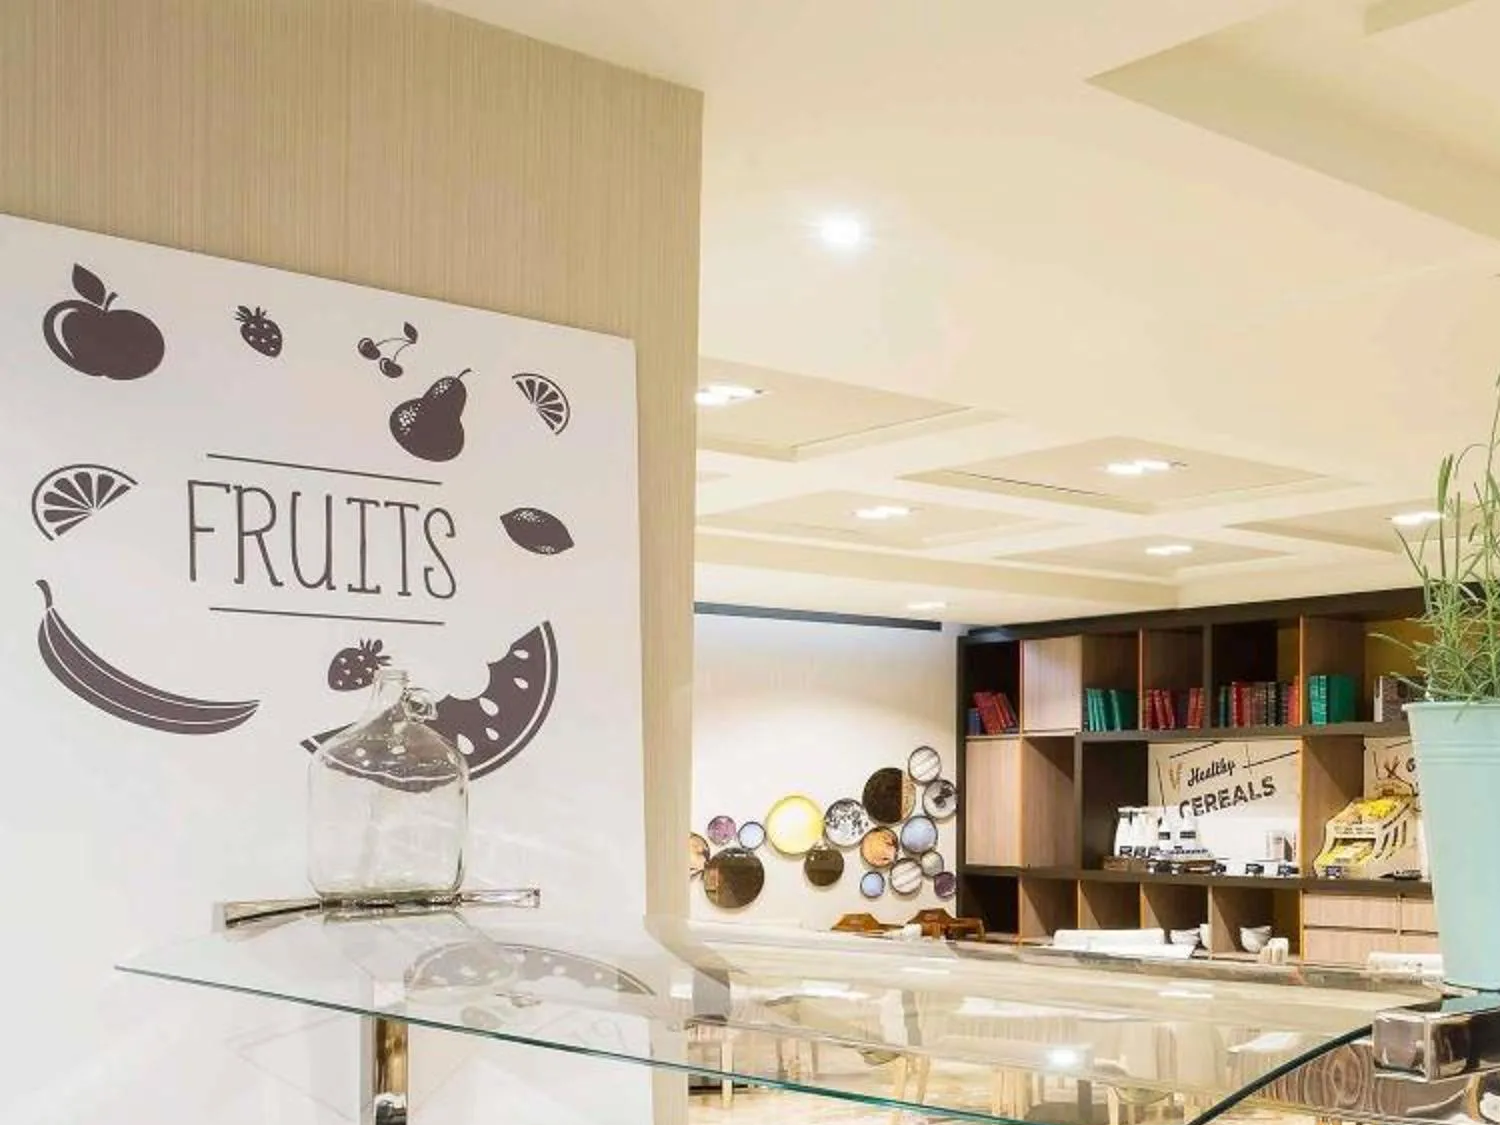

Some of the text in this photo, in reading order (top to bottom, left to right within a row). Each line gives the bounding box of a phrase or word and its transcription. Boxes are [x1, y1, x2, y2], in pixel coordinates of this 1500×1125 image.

[186, 479, 457, 599] FRUITS
[1187, 757, 1236, 787] Healthy
[1179, 775, 1276, 819] CEREALS
